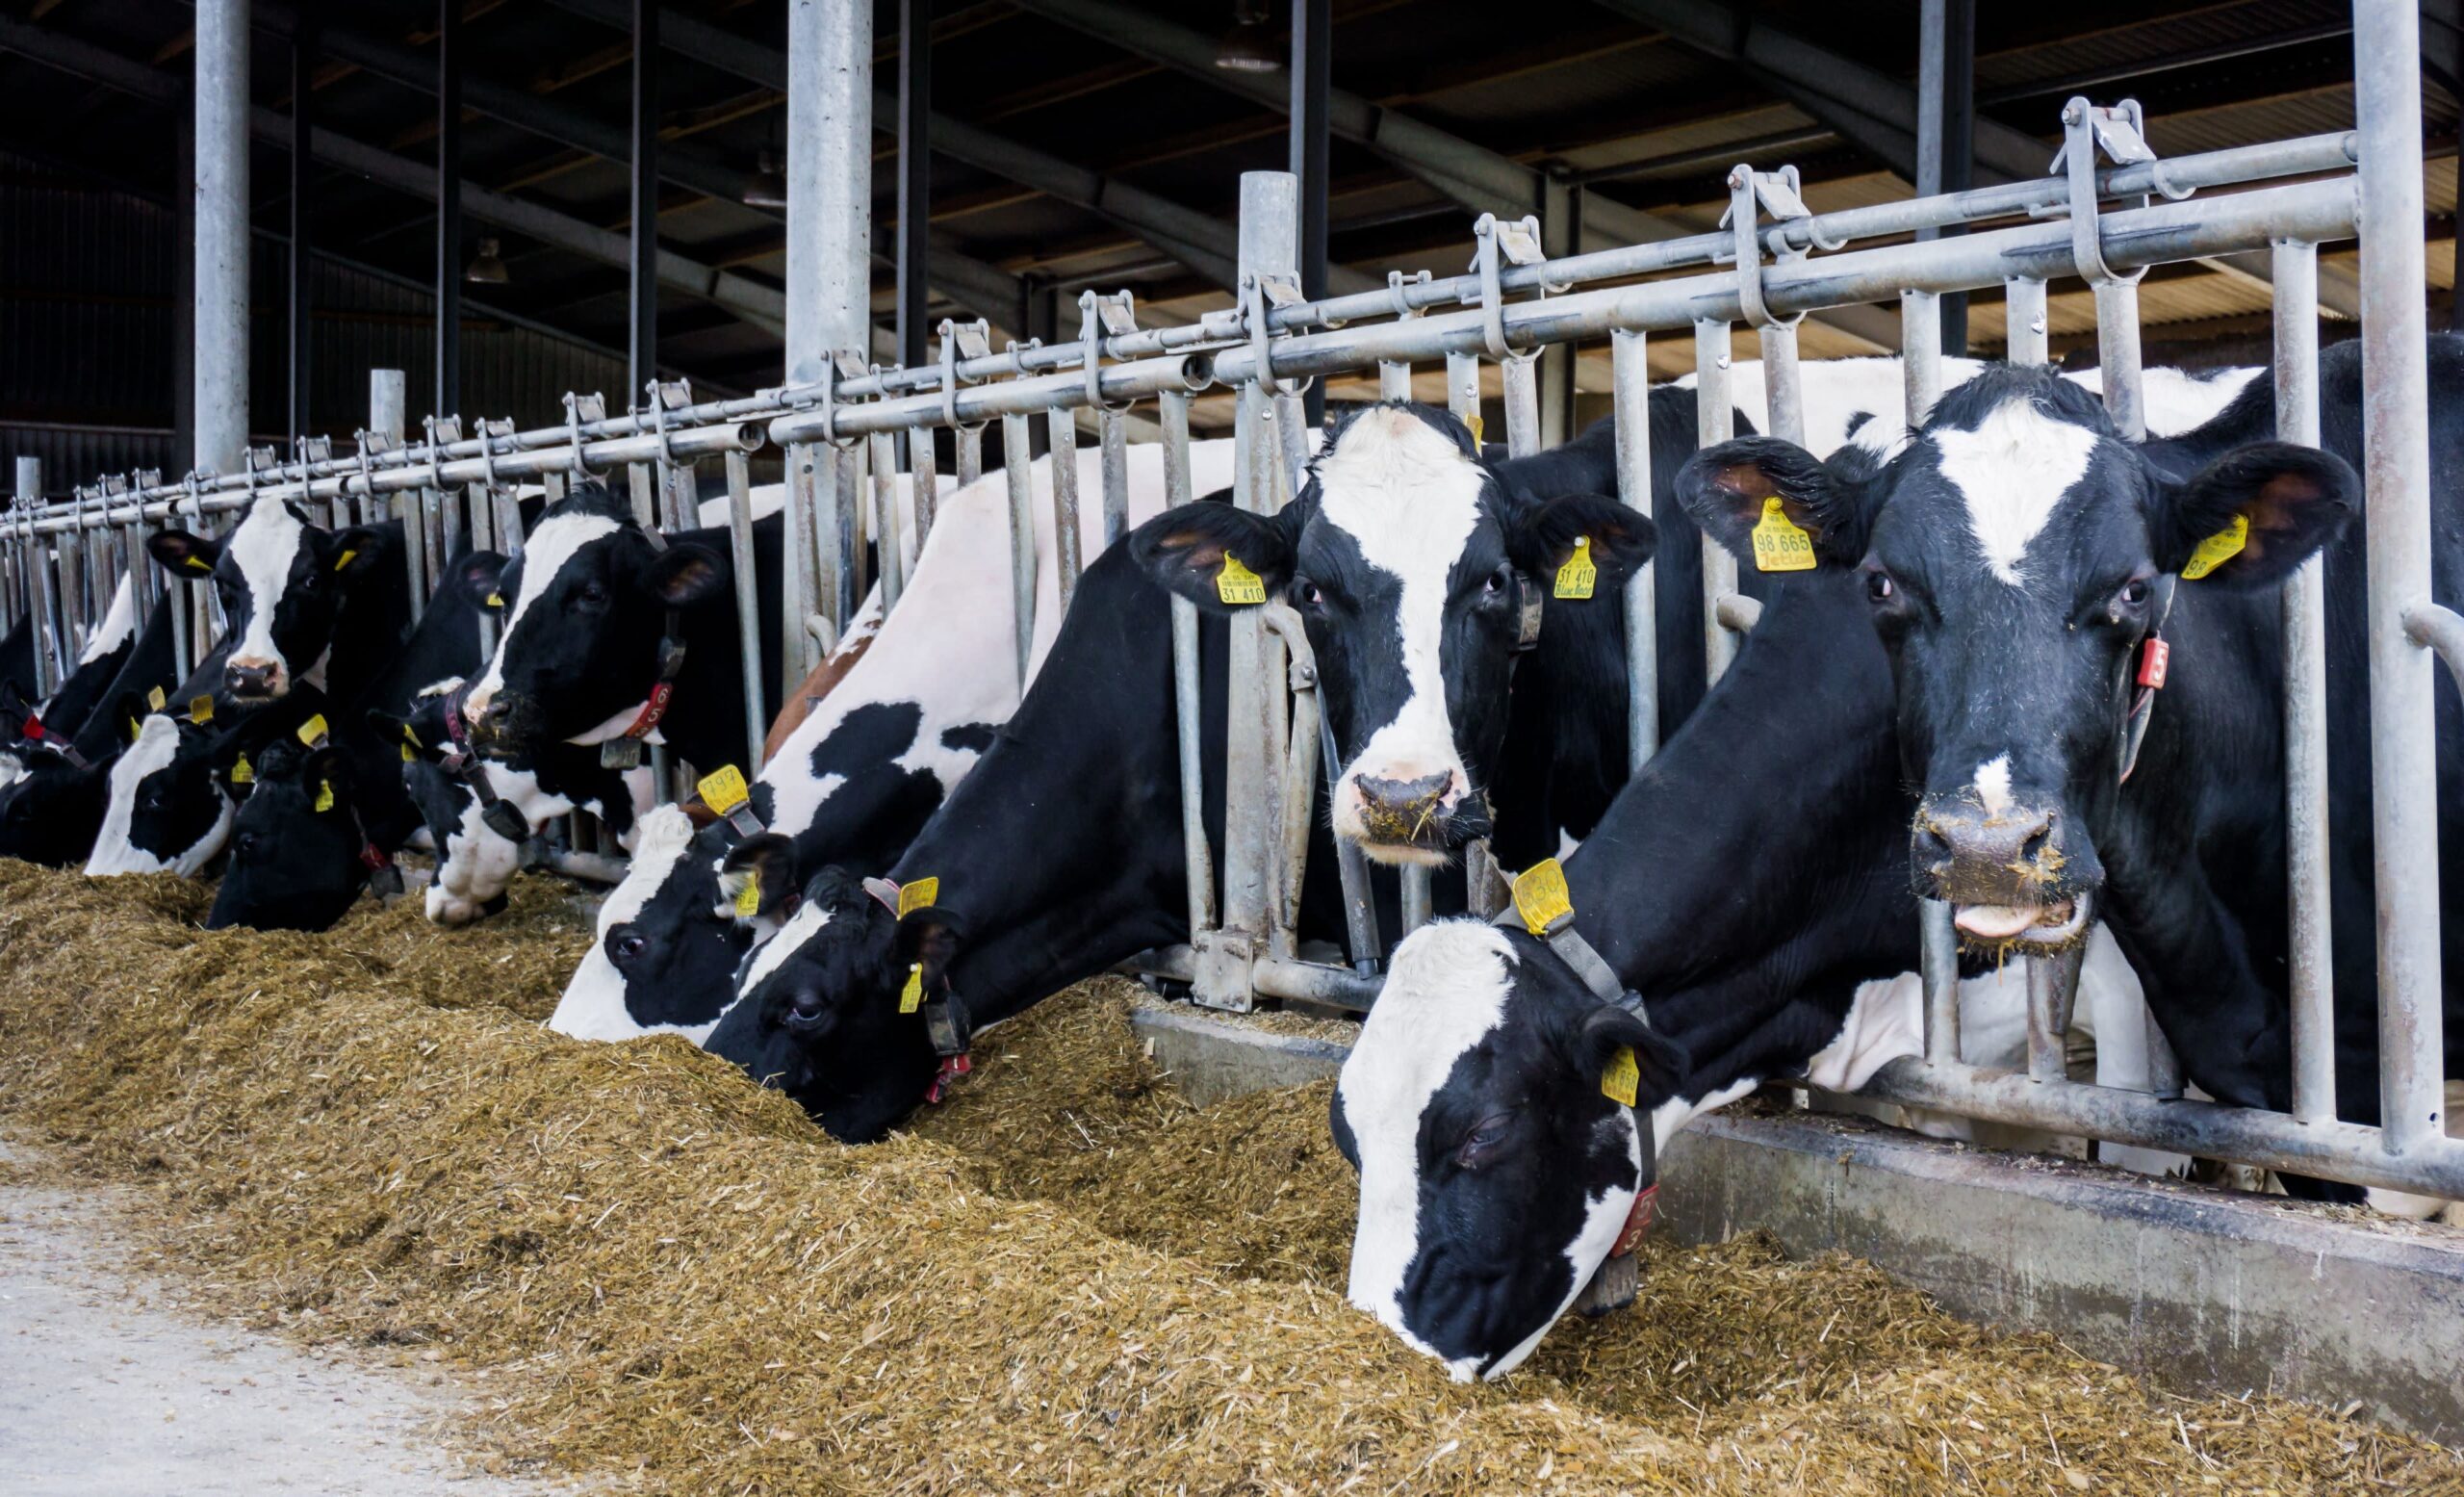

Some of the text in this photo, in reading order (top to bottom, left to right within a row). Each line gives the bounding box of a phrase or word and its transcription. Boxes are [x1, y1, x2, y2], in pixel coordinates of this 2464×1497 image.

[1757, 533, 1809, 552] 98 665
[1558, 568, 1594, 584] 31 410
[1222, 587, 1264, 601] 31 410
